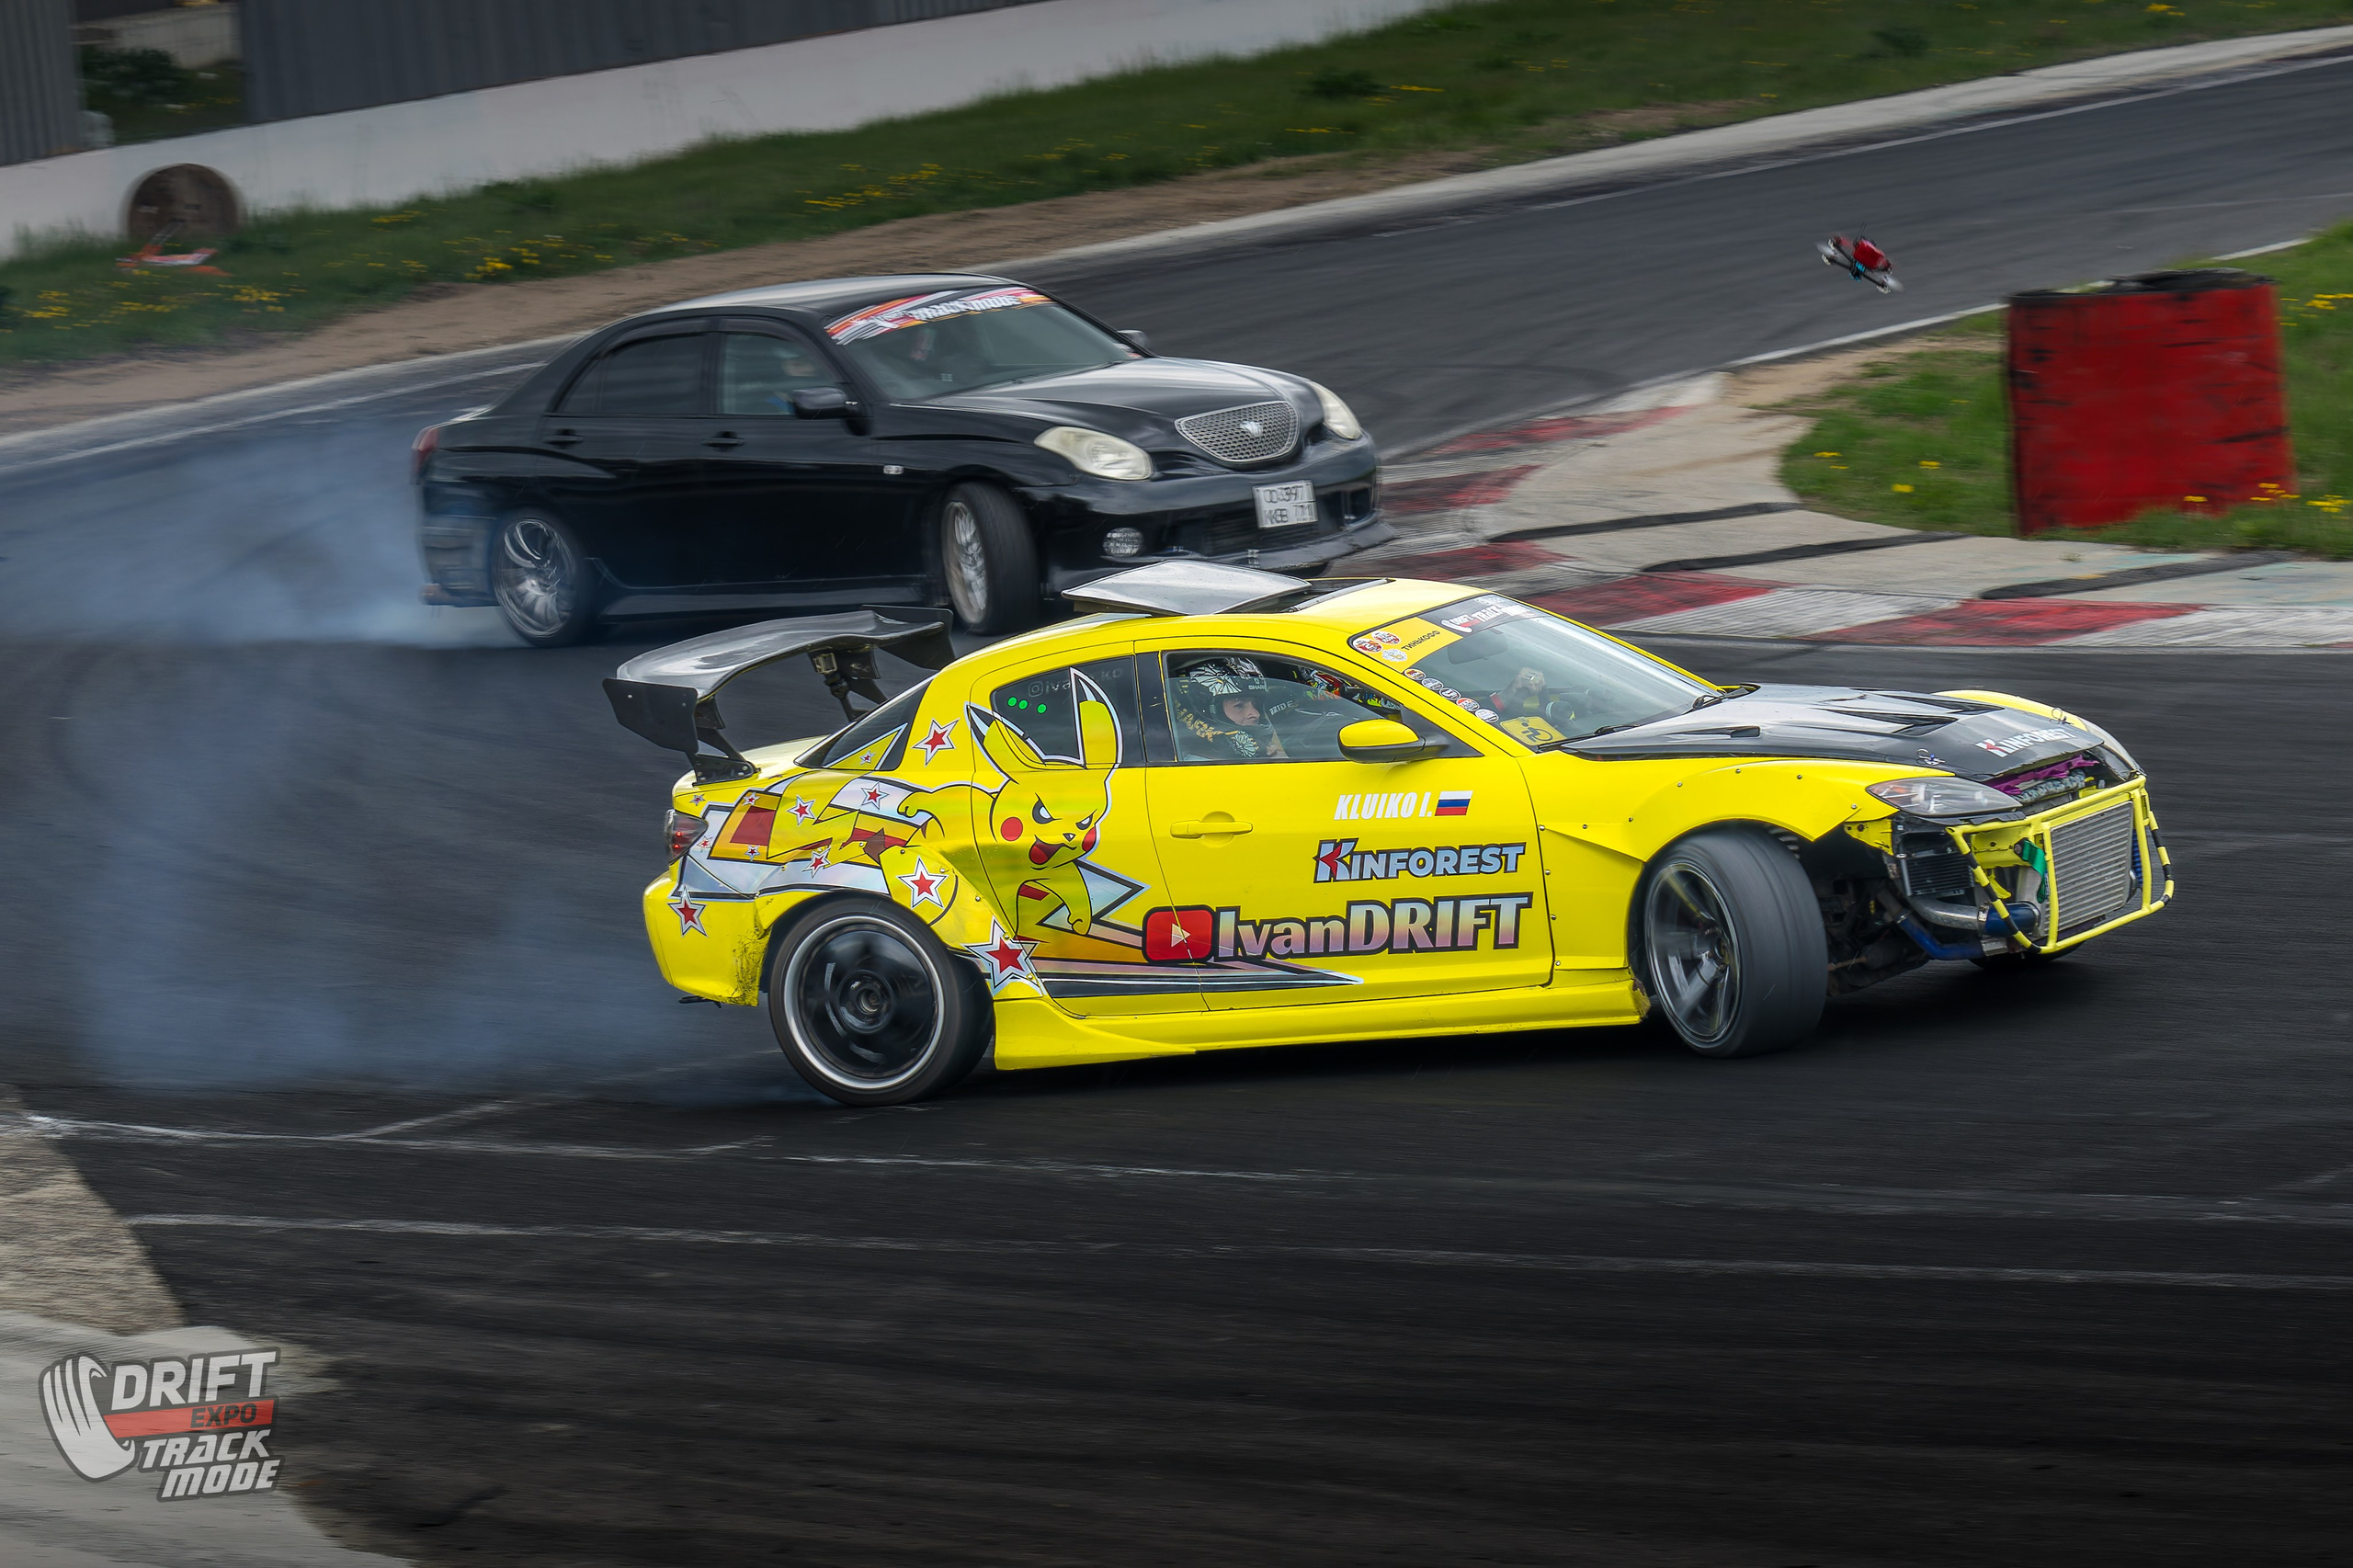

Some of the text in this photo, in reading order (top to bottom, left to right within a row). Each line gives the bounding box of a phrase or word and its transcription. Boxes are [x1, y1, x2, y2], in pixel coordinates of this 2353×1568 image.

[1975, 728, 2076, 758] KINFOREST
[1334, 791, 1433, 821] KLUIKO I.
[1313, 838, 1526, 883] KINFOREST
[1215, 892, 1533, 961] IvanDRIFT
